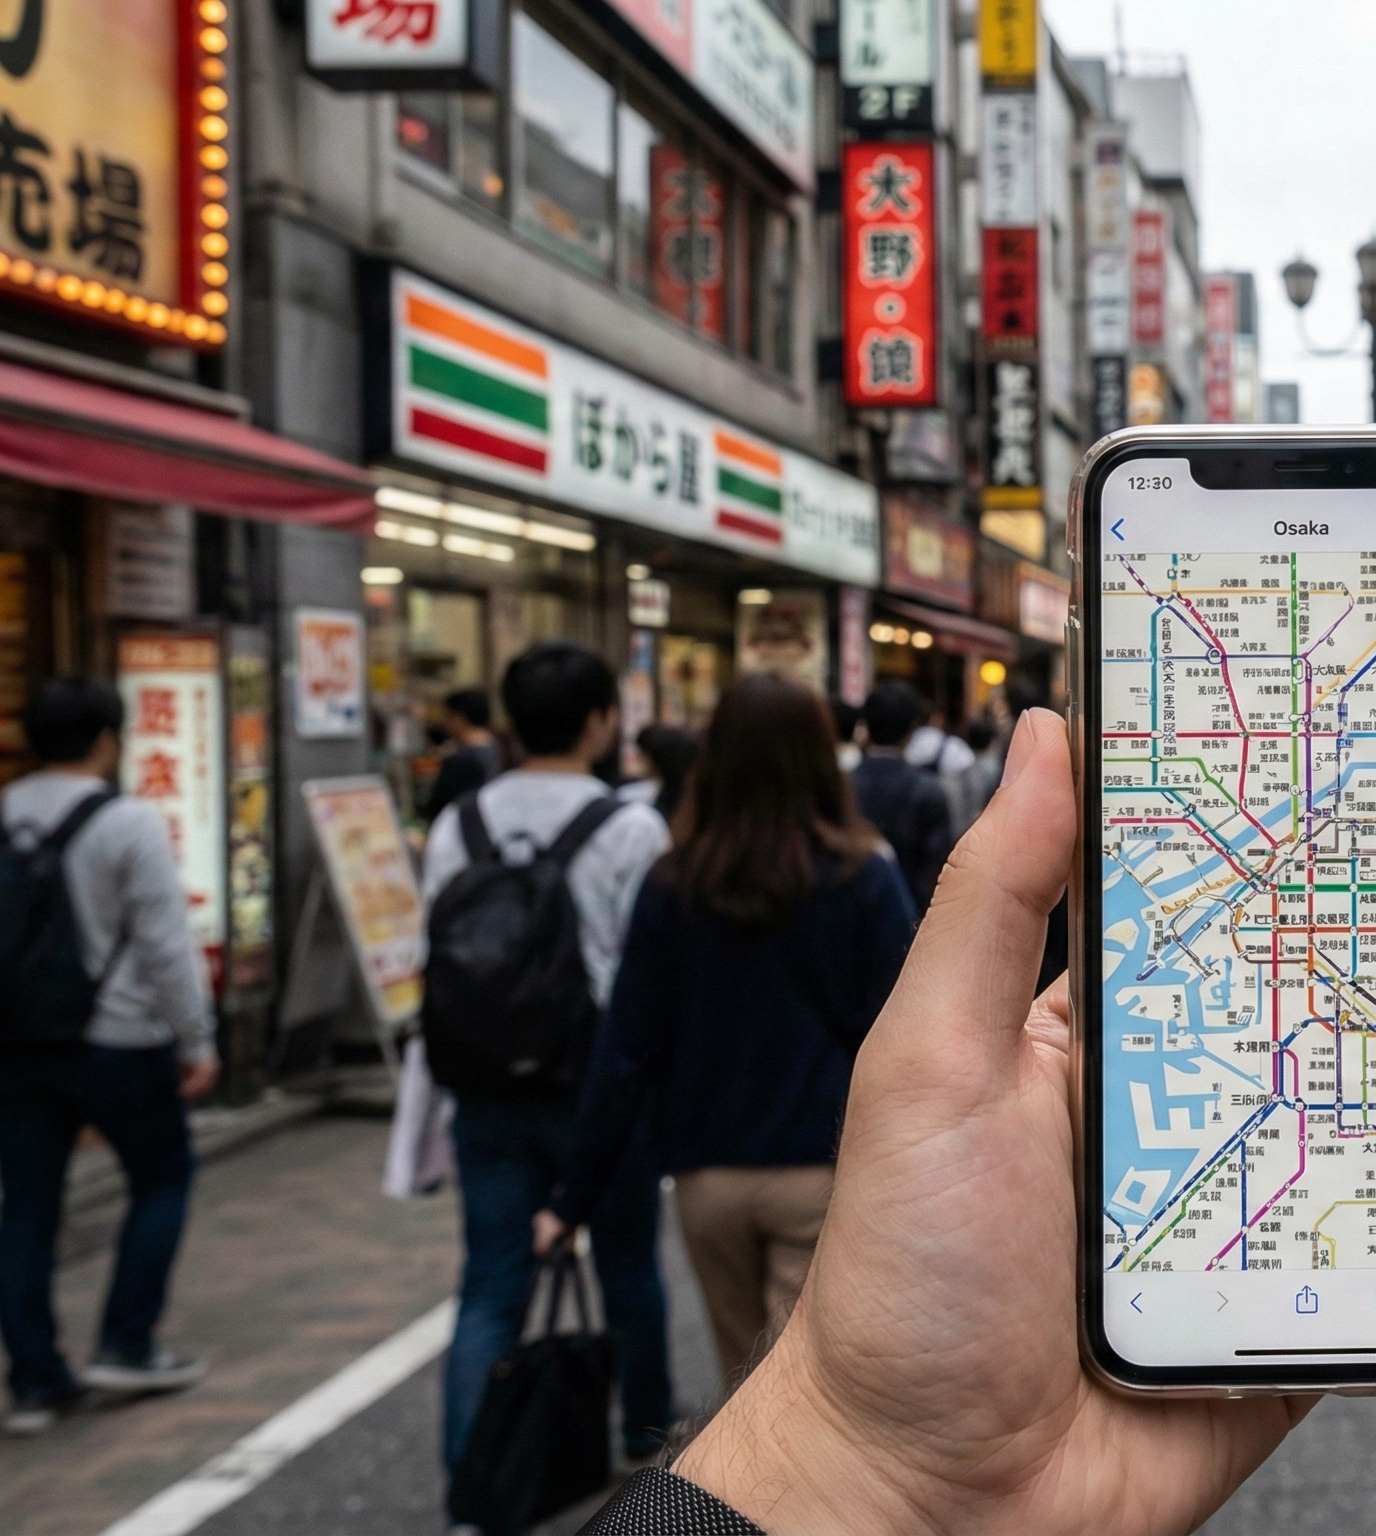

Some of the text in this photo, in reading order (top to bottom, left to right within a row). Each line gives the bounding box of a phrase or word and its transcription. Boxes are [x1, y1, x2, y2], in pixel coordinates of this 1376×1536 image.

[858, 85, 923, 120] 2F
[1128, 476, 1173, 490] 12:30
[1273, 520, 1330, 536] Osaka
